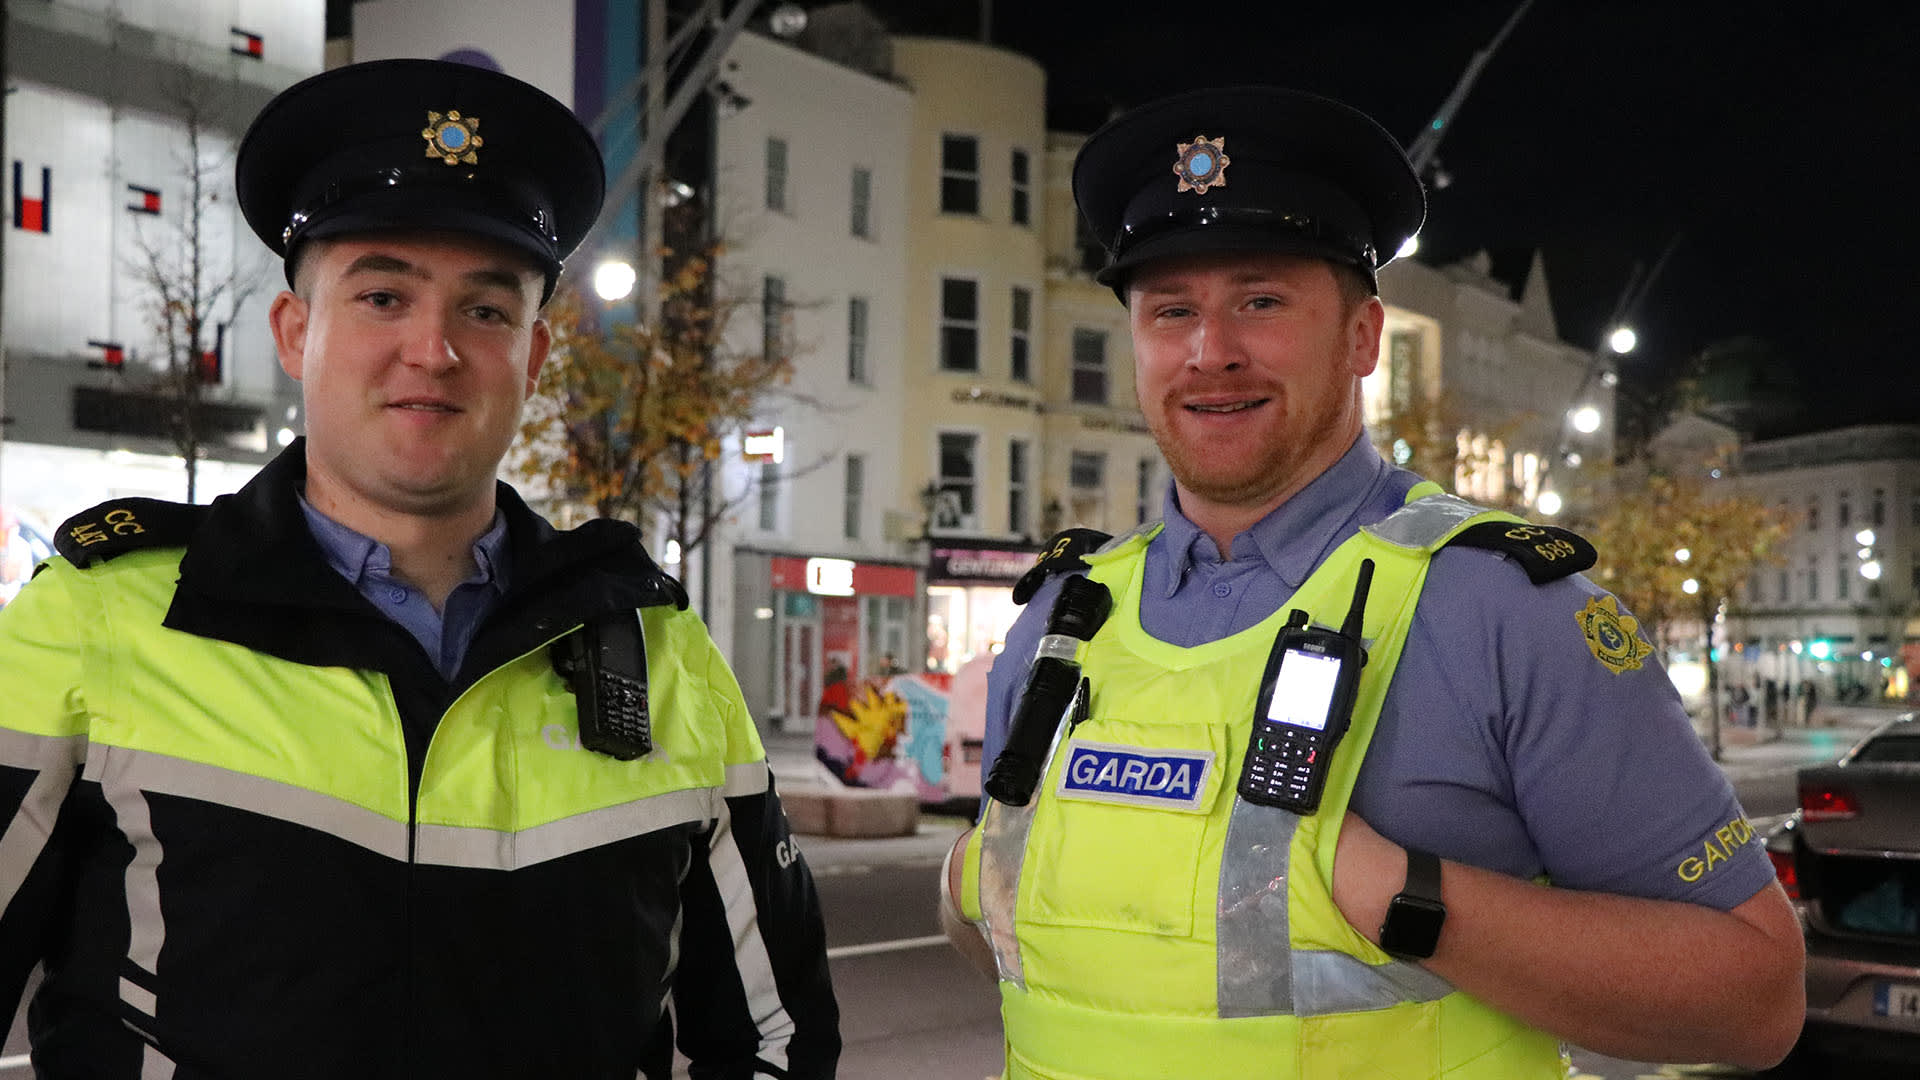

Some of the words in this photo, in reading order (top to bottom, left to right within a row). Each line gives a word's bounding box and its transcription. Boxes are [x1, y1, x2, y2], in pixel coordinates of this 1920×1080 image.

[70, 522, 109, 547] 447
[105, 509, 145, 536] CC
[1505, 526, 1546, 540] CC
[1535, 539, 1576, 561] 689
[1072, 754, 1191, 794] GARDA
[1678, 819, 1754, 882] GARD
